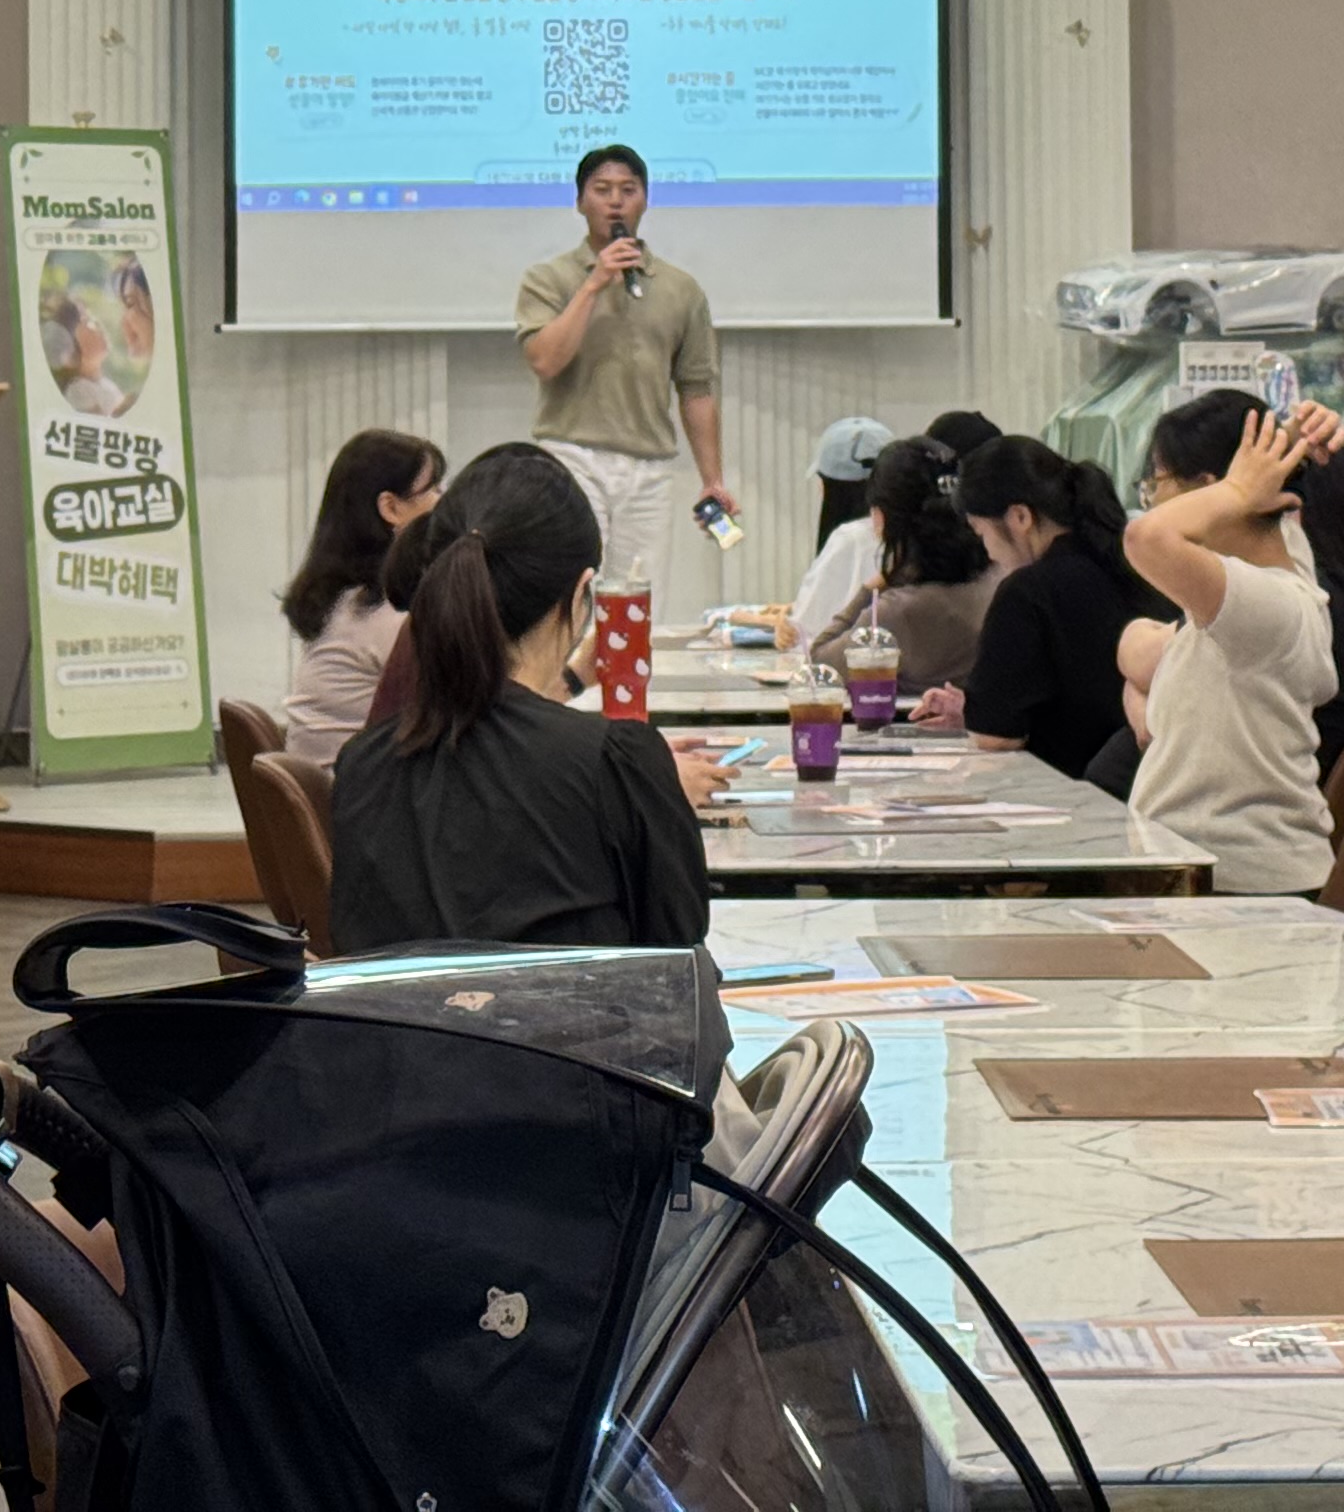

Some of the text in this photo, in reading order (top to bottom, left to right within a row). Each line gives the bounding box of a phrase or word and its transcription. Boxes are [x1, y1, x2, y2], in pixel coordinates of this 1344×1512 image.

[22, 194, 157, 221] MomSalon
[44, 419, 164, 476] 선물팡팡
[52, 480, 177, 534] 육아교실
[56, 550, 180, 605] 대박혜택
